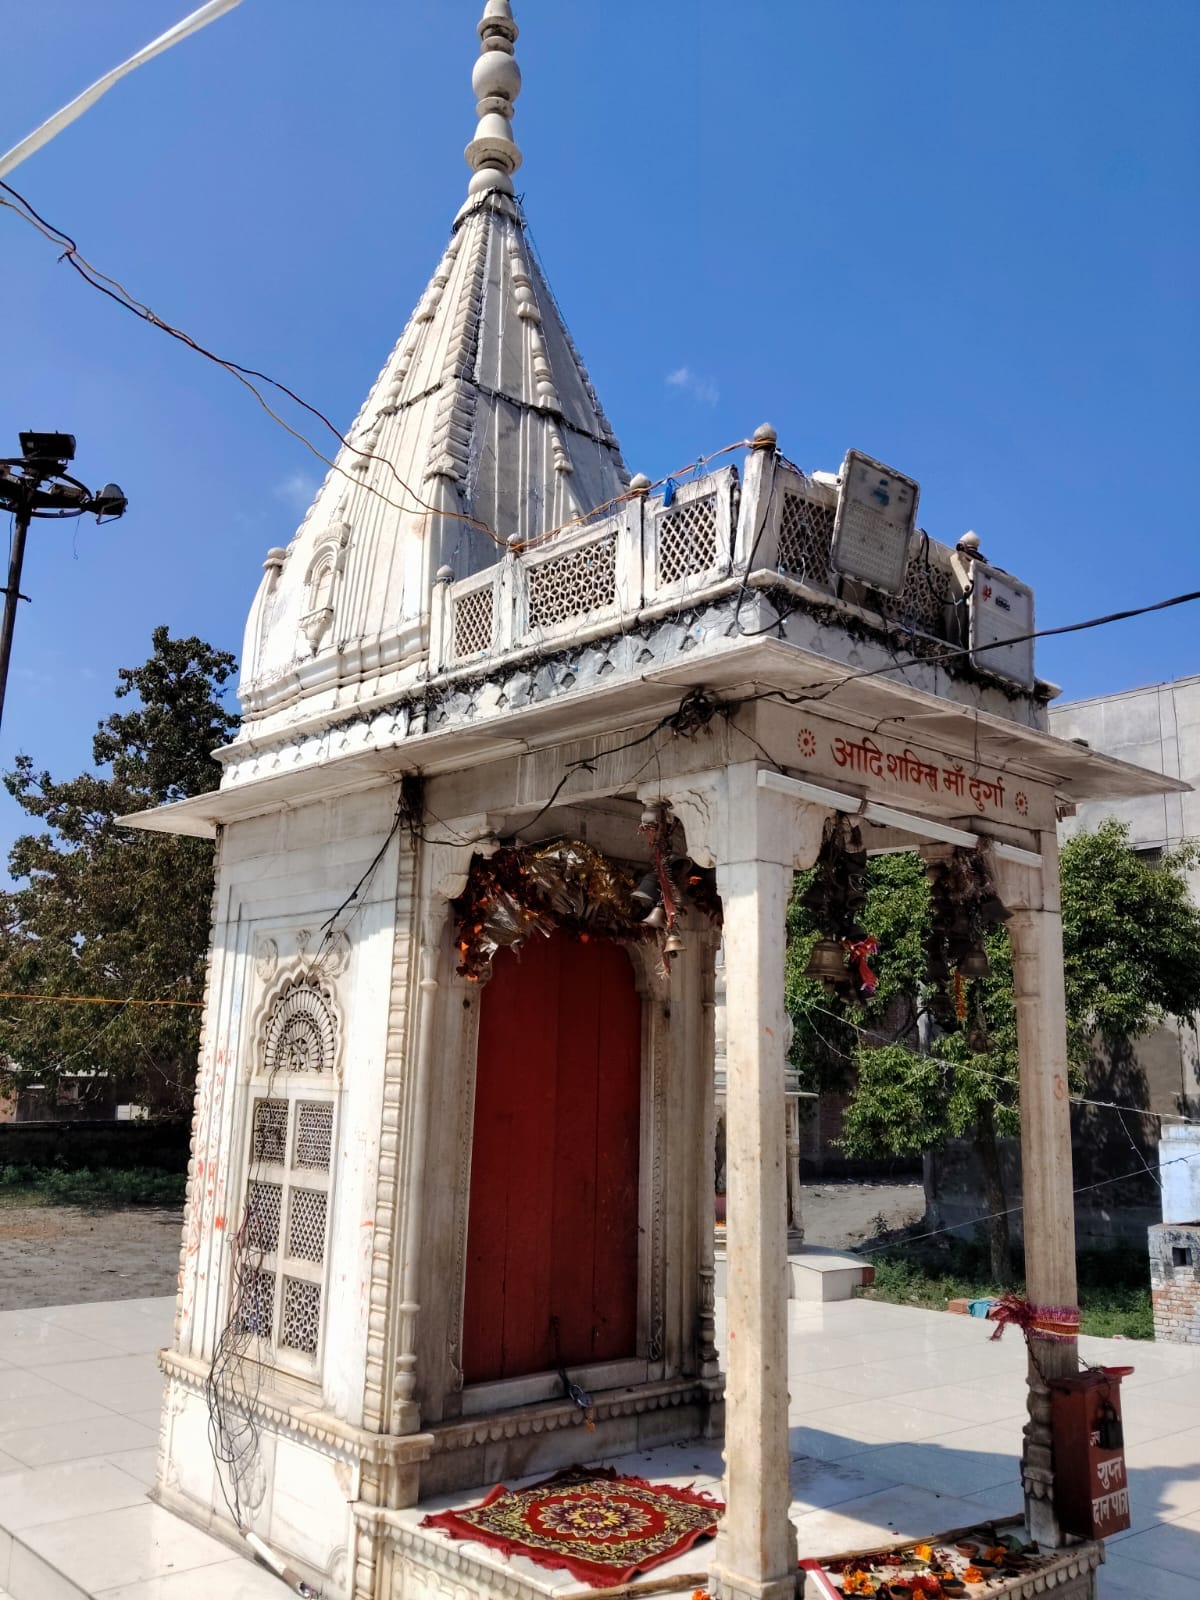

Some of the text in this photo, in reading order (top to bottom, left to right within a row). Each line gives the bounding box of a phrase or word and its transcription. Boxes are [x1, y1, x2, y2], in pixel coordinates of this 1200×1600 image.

[831, 737, 886, 781] आदि
[887, 749, 938, 792] शक्ति
[969, 776, 1005, 811] दुर्गा
[1097, 1456, 1122, 1489] गुप्त
